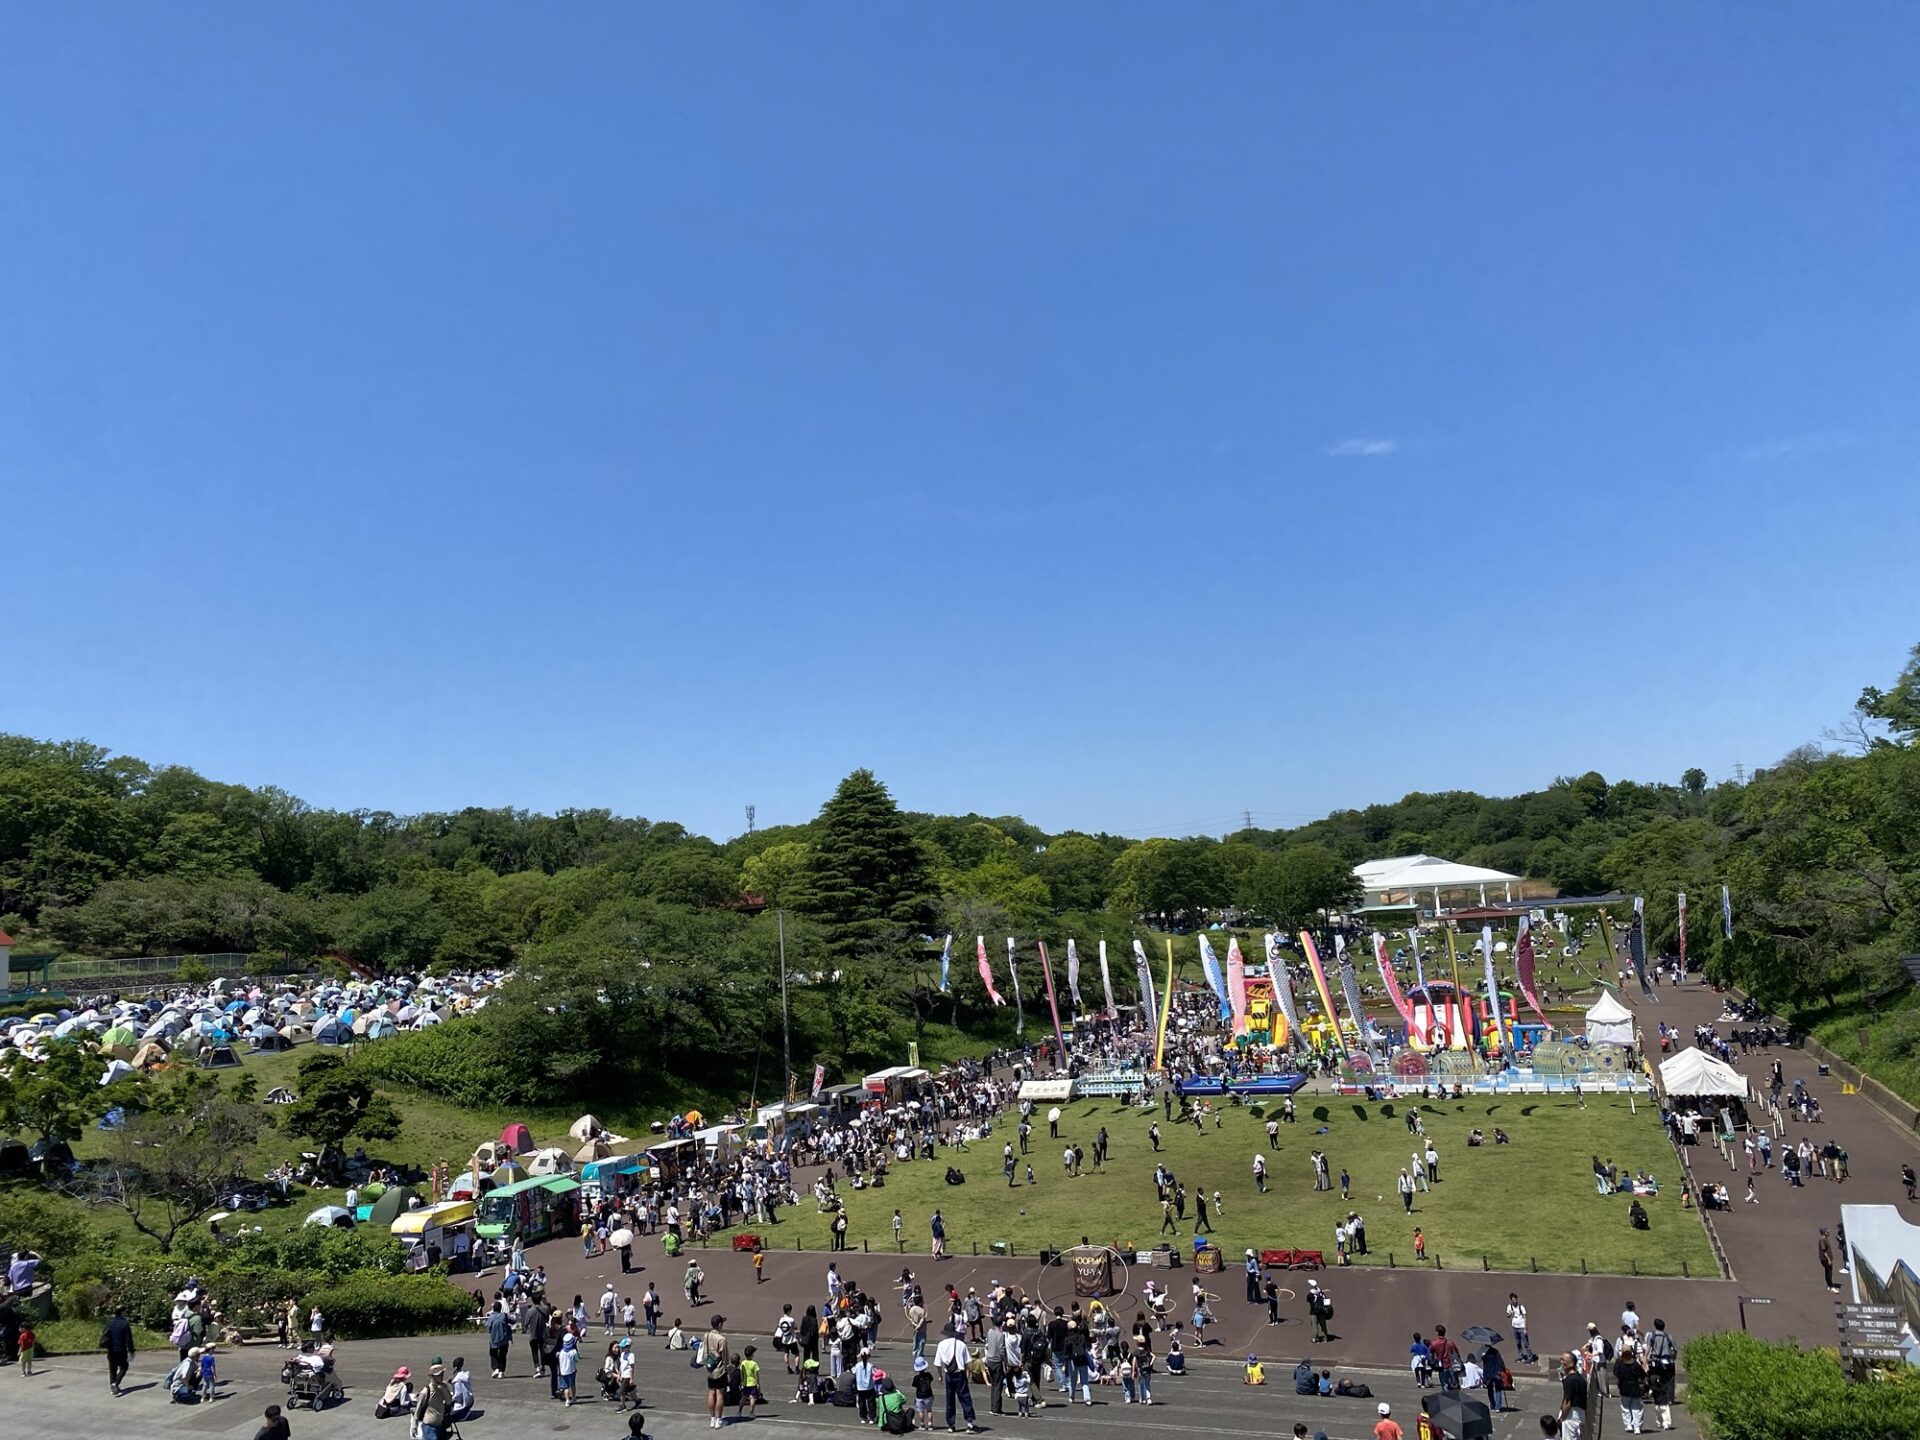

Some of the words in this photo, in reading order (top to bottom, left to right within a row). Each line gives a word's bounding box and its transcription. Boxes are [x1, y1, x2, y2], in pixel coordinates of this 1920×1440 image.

[1072, 1256, 1107, 1264] HOOPMAN
[1077, 1267, 1102, 1276] YU-YA
[1420, 1427, 1430, 1440] 10
